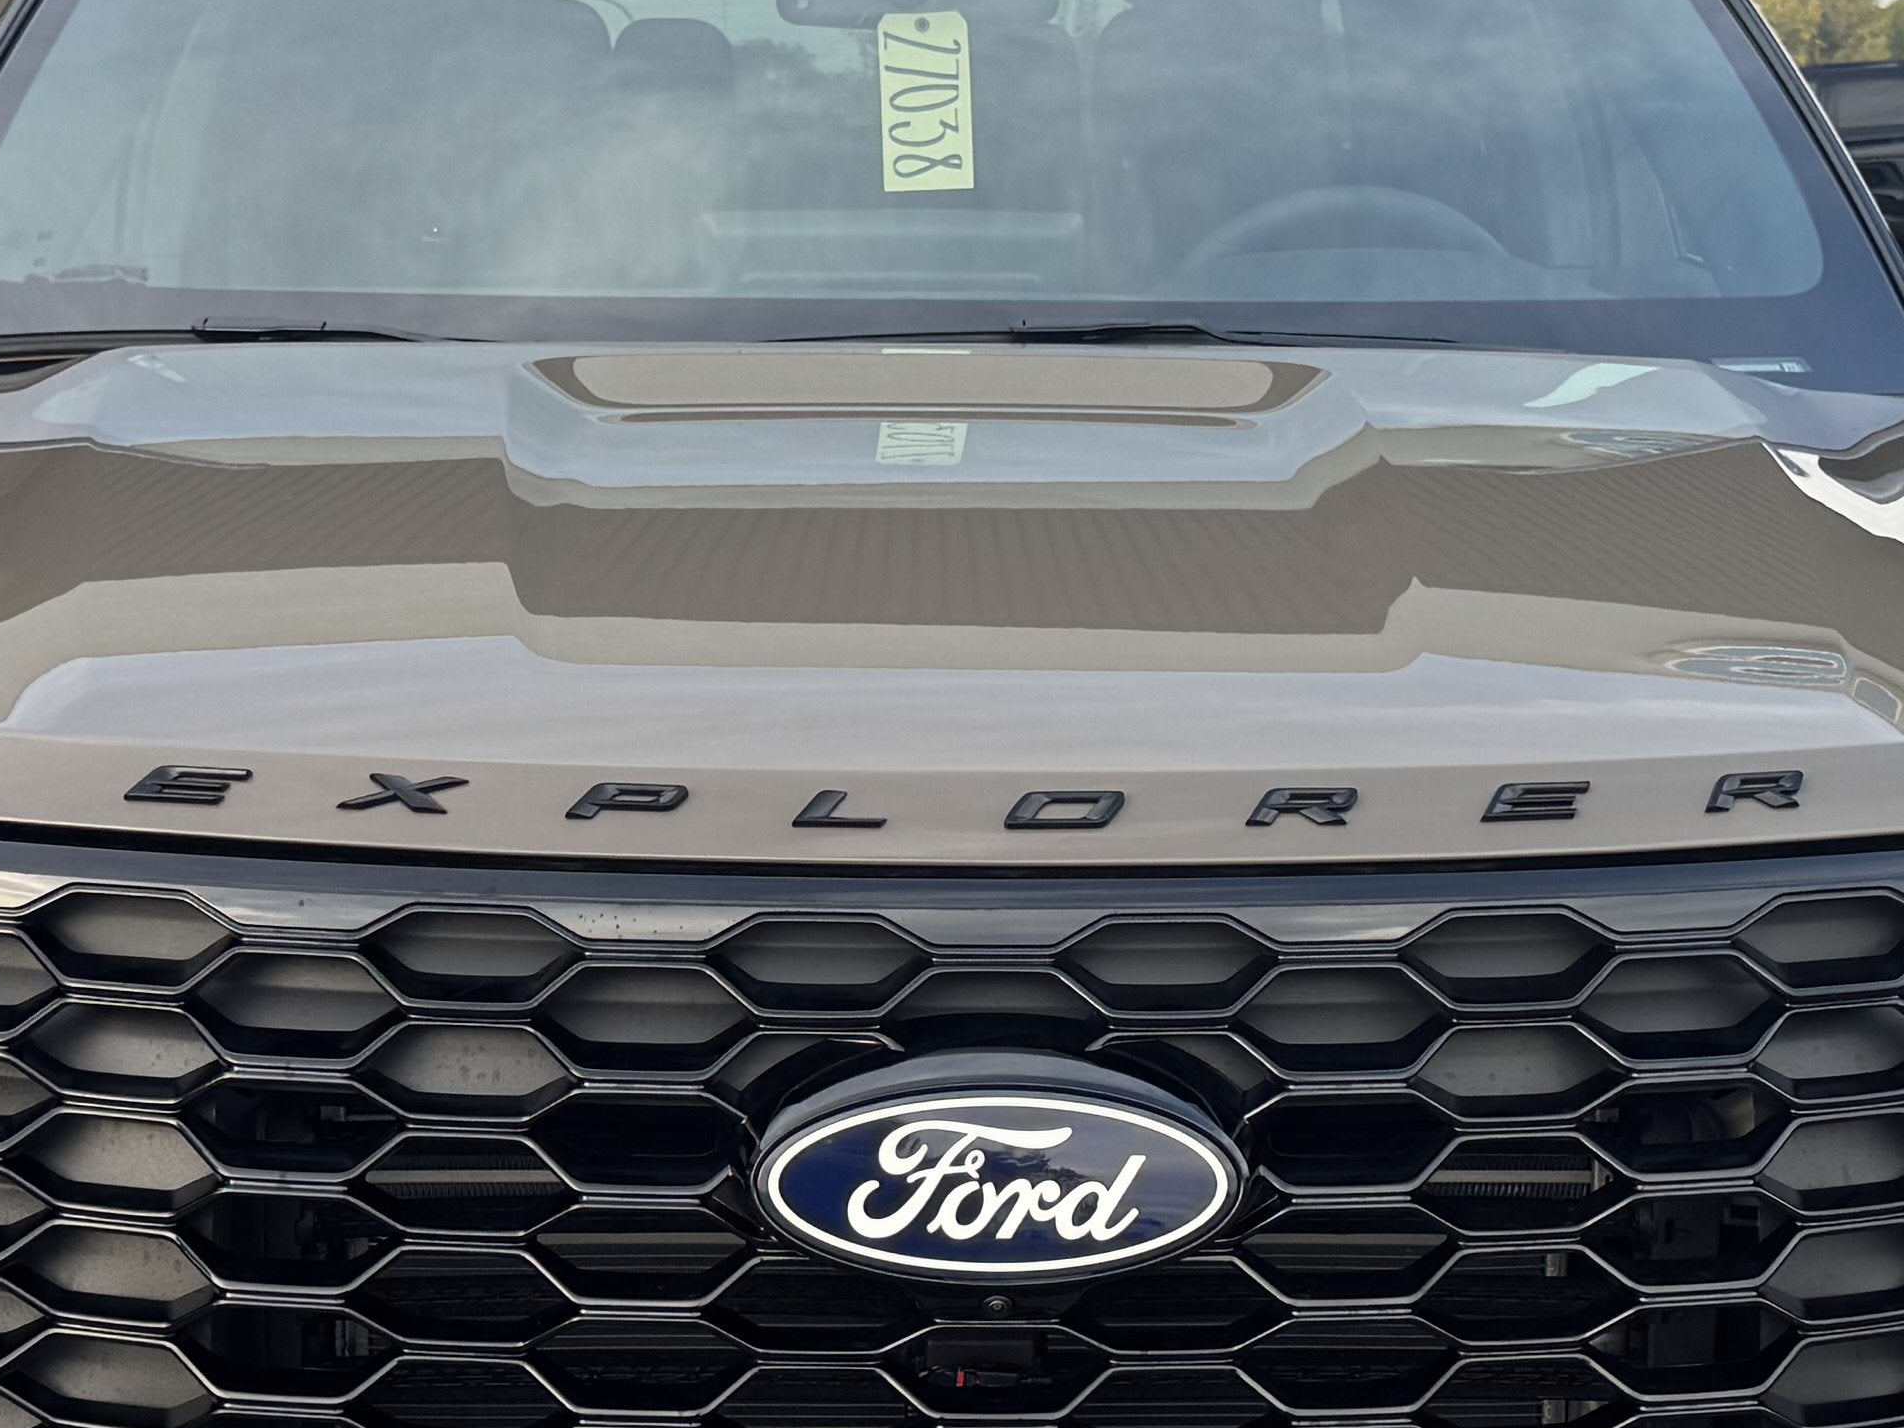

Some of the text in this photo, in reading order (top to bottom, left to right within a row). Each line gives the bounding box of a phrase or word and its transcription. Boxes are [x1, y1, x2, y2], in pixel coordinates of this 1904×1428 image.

[882, 30, 963, 179] 27038
[123, 764, 1805, 831] EXPLORER
[847, 1119, 1147, 1241] Ford
